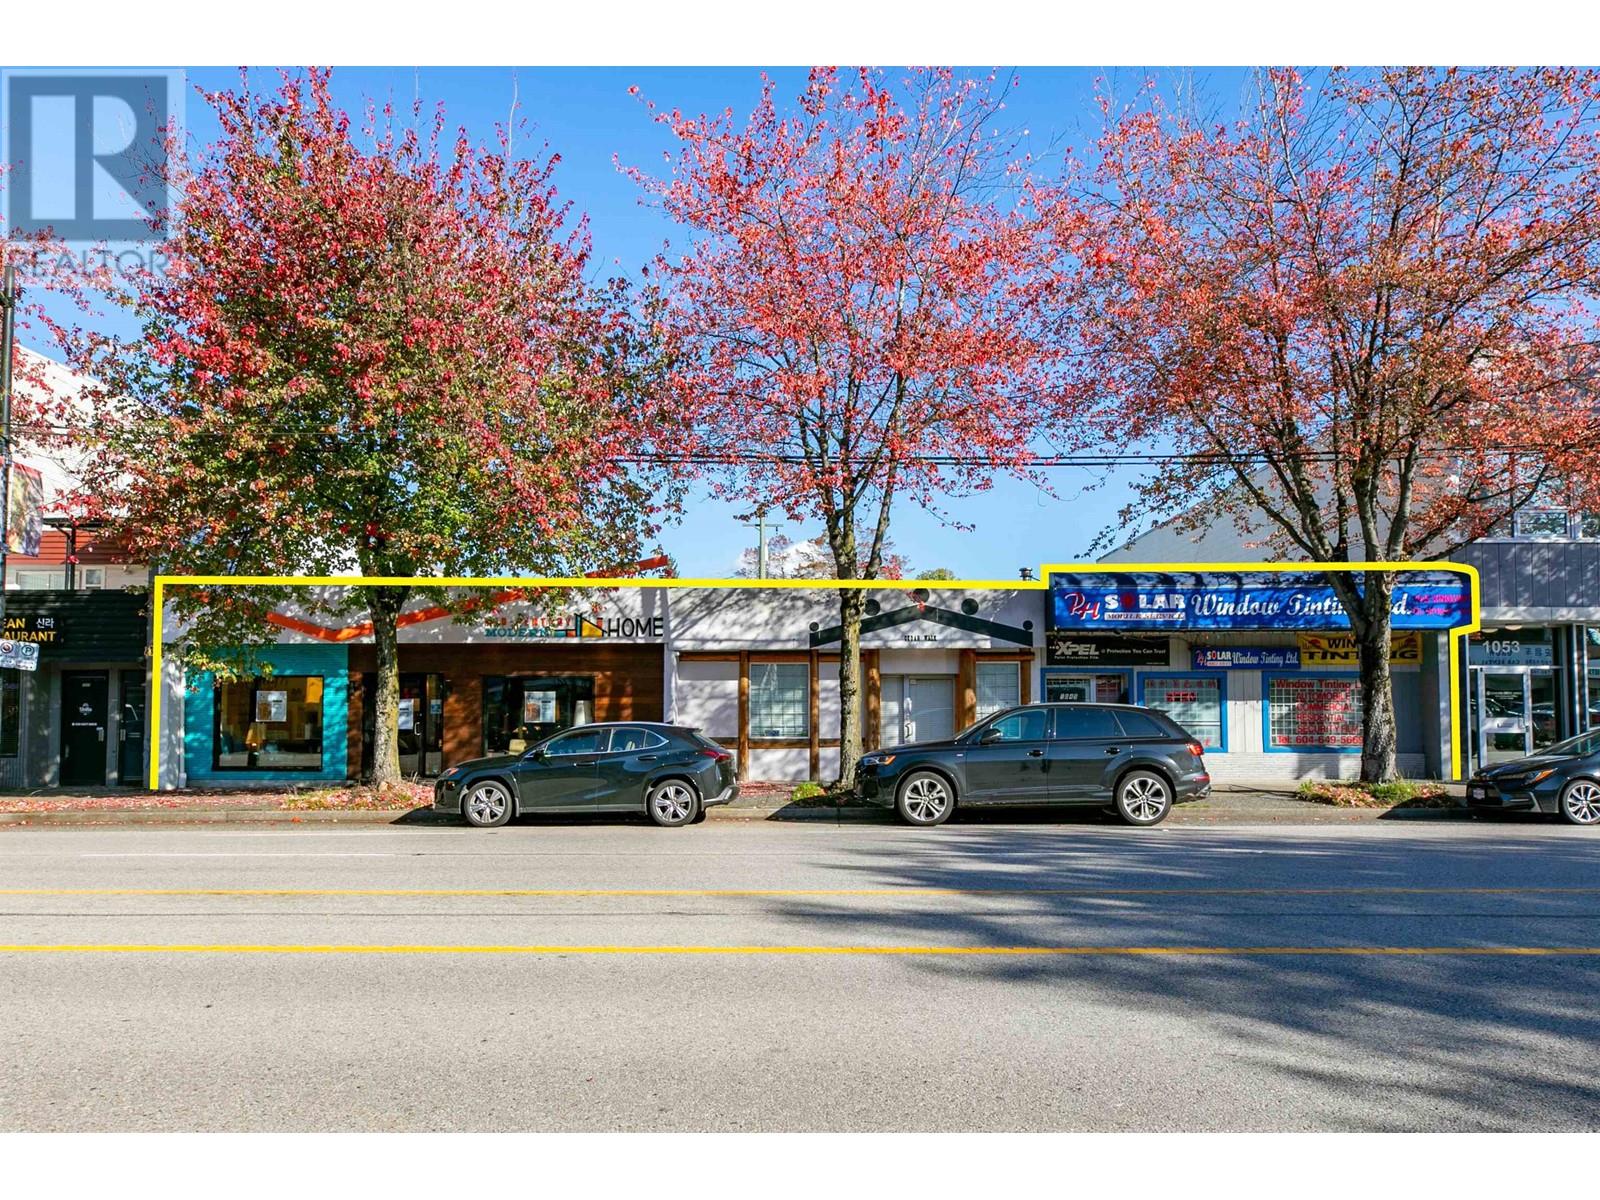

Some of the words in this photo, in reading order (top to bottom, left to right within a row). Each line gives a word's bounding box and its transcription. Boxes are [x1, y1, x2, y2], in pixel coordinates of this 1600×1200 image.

[1104, 595, 1186, 609] SOLAR
[1191, 595, 1280, 616] Window
[1286, 594, 1348, 616] Tinti
[36, 617, 54, 629] 신라
[607, 617, 664, 637] HOME
[1055, 641, 1100, 656] XPEL
[1483, 640, 1521, 654] 1053
[1207, 651, 1232, 661] SOLAR
[1232, 652, 1259, 664] Window
[1261, 652, 1284, 668] Tinting
[1276, 679, 1314, 688] Window
[1318, 679, 1351, 691] Tinting
[1296, 691, 1350, 701] AUTOMOBILE
